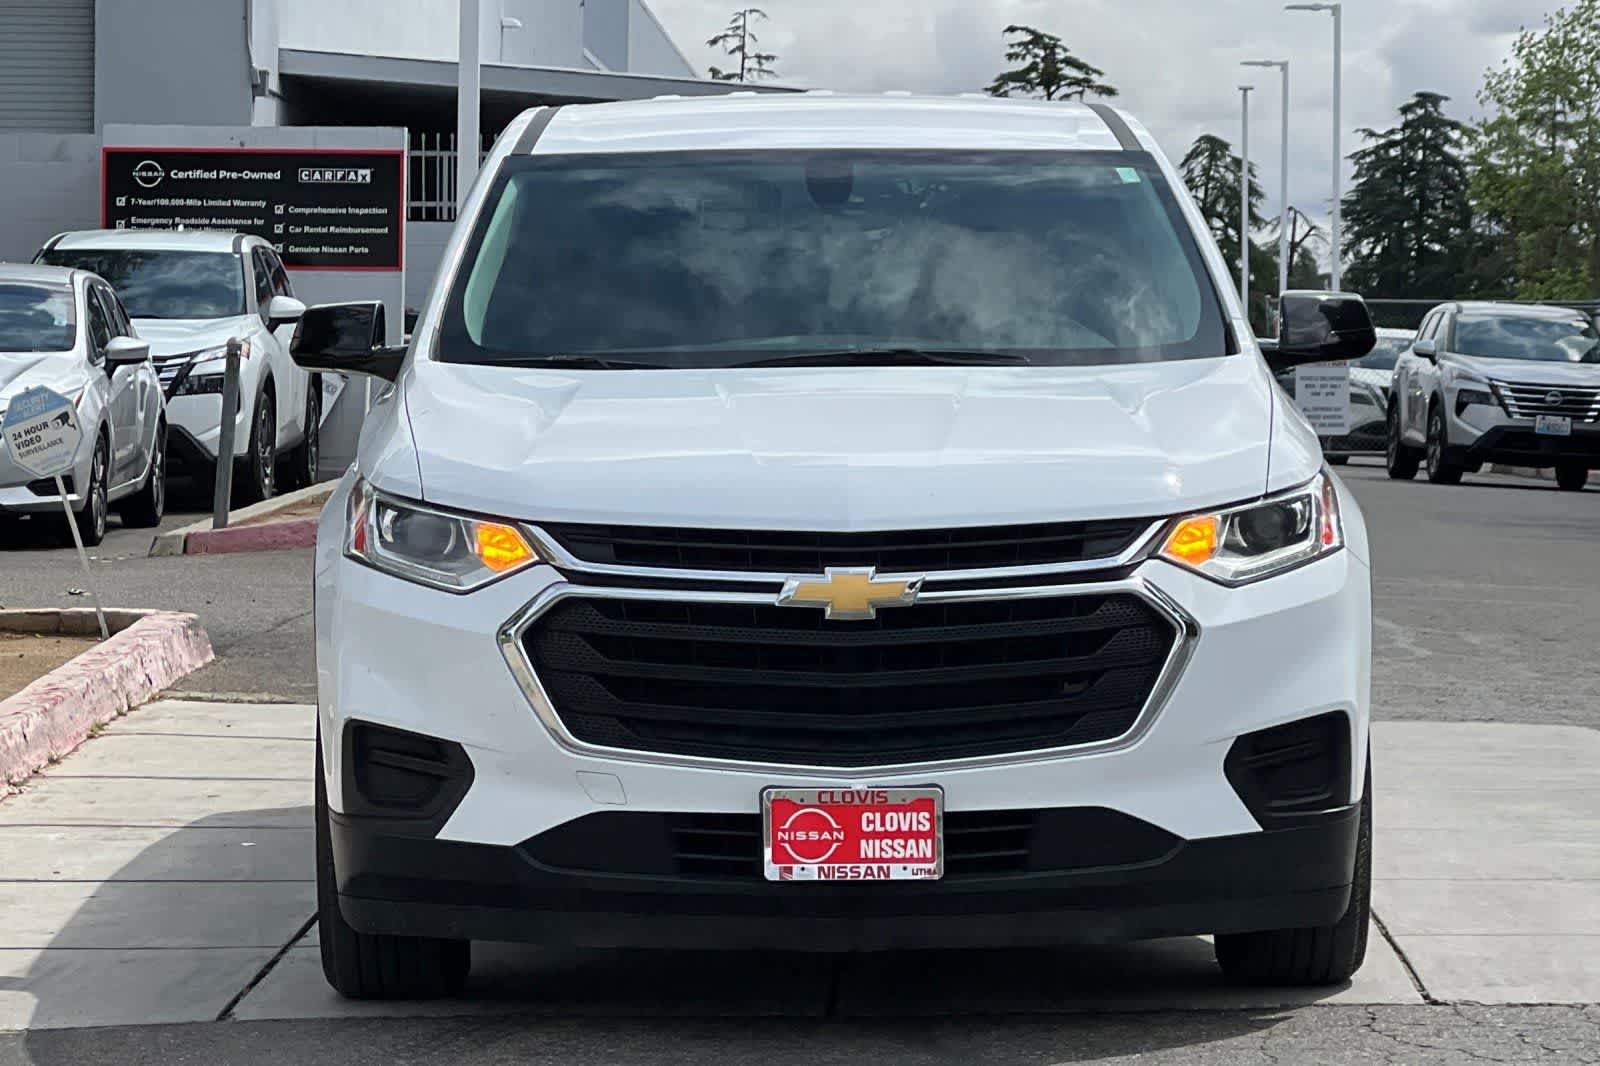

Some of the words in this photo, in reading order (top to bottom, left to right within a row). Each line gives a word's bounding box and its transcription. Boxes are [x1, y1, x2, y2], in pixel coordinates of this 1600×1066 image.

[170, 169, 217, 179] Certified
[219, 169, 281, 179] Pre-Owned
[299, 168, 371, 183] CARFAX
[233, 200, 267, 208] Warranty
[288, 206, 347, 215] Comprehensive
[348, 206, 388, 215] Inspection
[131, 217, 173, 225] Emergency
[288, 225, 302, 233] Car
[330, 226, 389, 234] Reimbursement
[288, 245, 320, 253] Genuine
[12, 431, 22, 441] 24
[23, 421, 49, 437] HOUR
[15, 434, 42, 450] VIDEO
[817, 790, 889, 804] CLOVIS
[861, 812, 931, 832] CLOVIS
[777, 831, 844, 841] NISSAN
[860, 839, 932, 859] NISSAN
[817, 866, 891, 879] NISSAN
